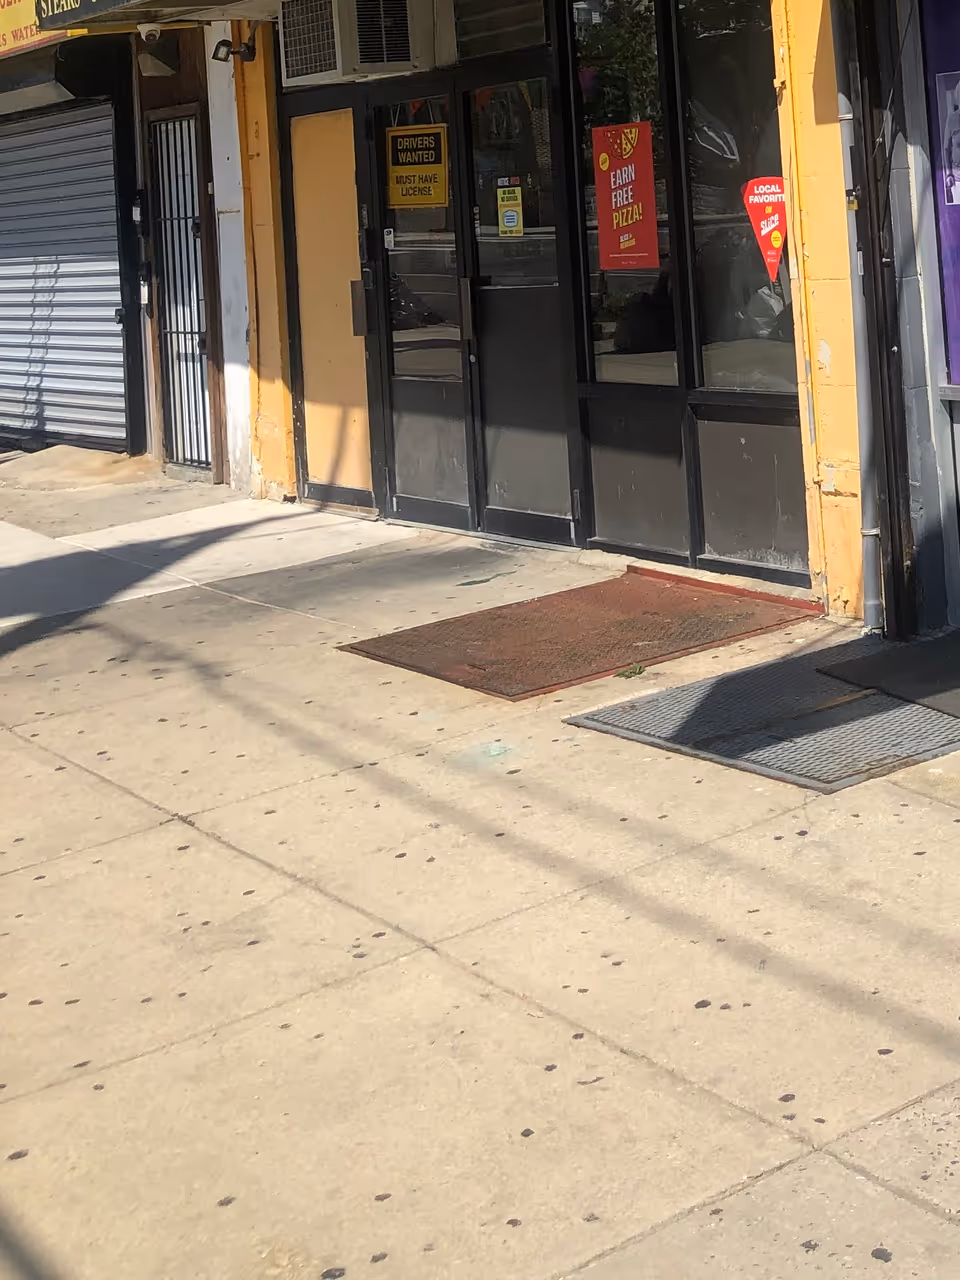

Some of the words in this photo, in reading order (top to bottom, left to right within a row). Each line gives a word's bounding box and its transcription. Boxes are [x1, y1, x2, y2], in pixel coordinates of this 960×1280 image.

[397, 136, 435, 150] DRIVERS
[398, 150, 435, 163] WANTED
[396, 174, 416, 185] MUST
[418, 173, 439, 184] HAVE
[610, 163, 635, 189] EARN
[401, 186, 433, 197] LICENSE
[754, 184, 781, 194] LOCAL
[611, 185, 634, 210] FREE
[613, 202, 643, 230] PIZZA!
